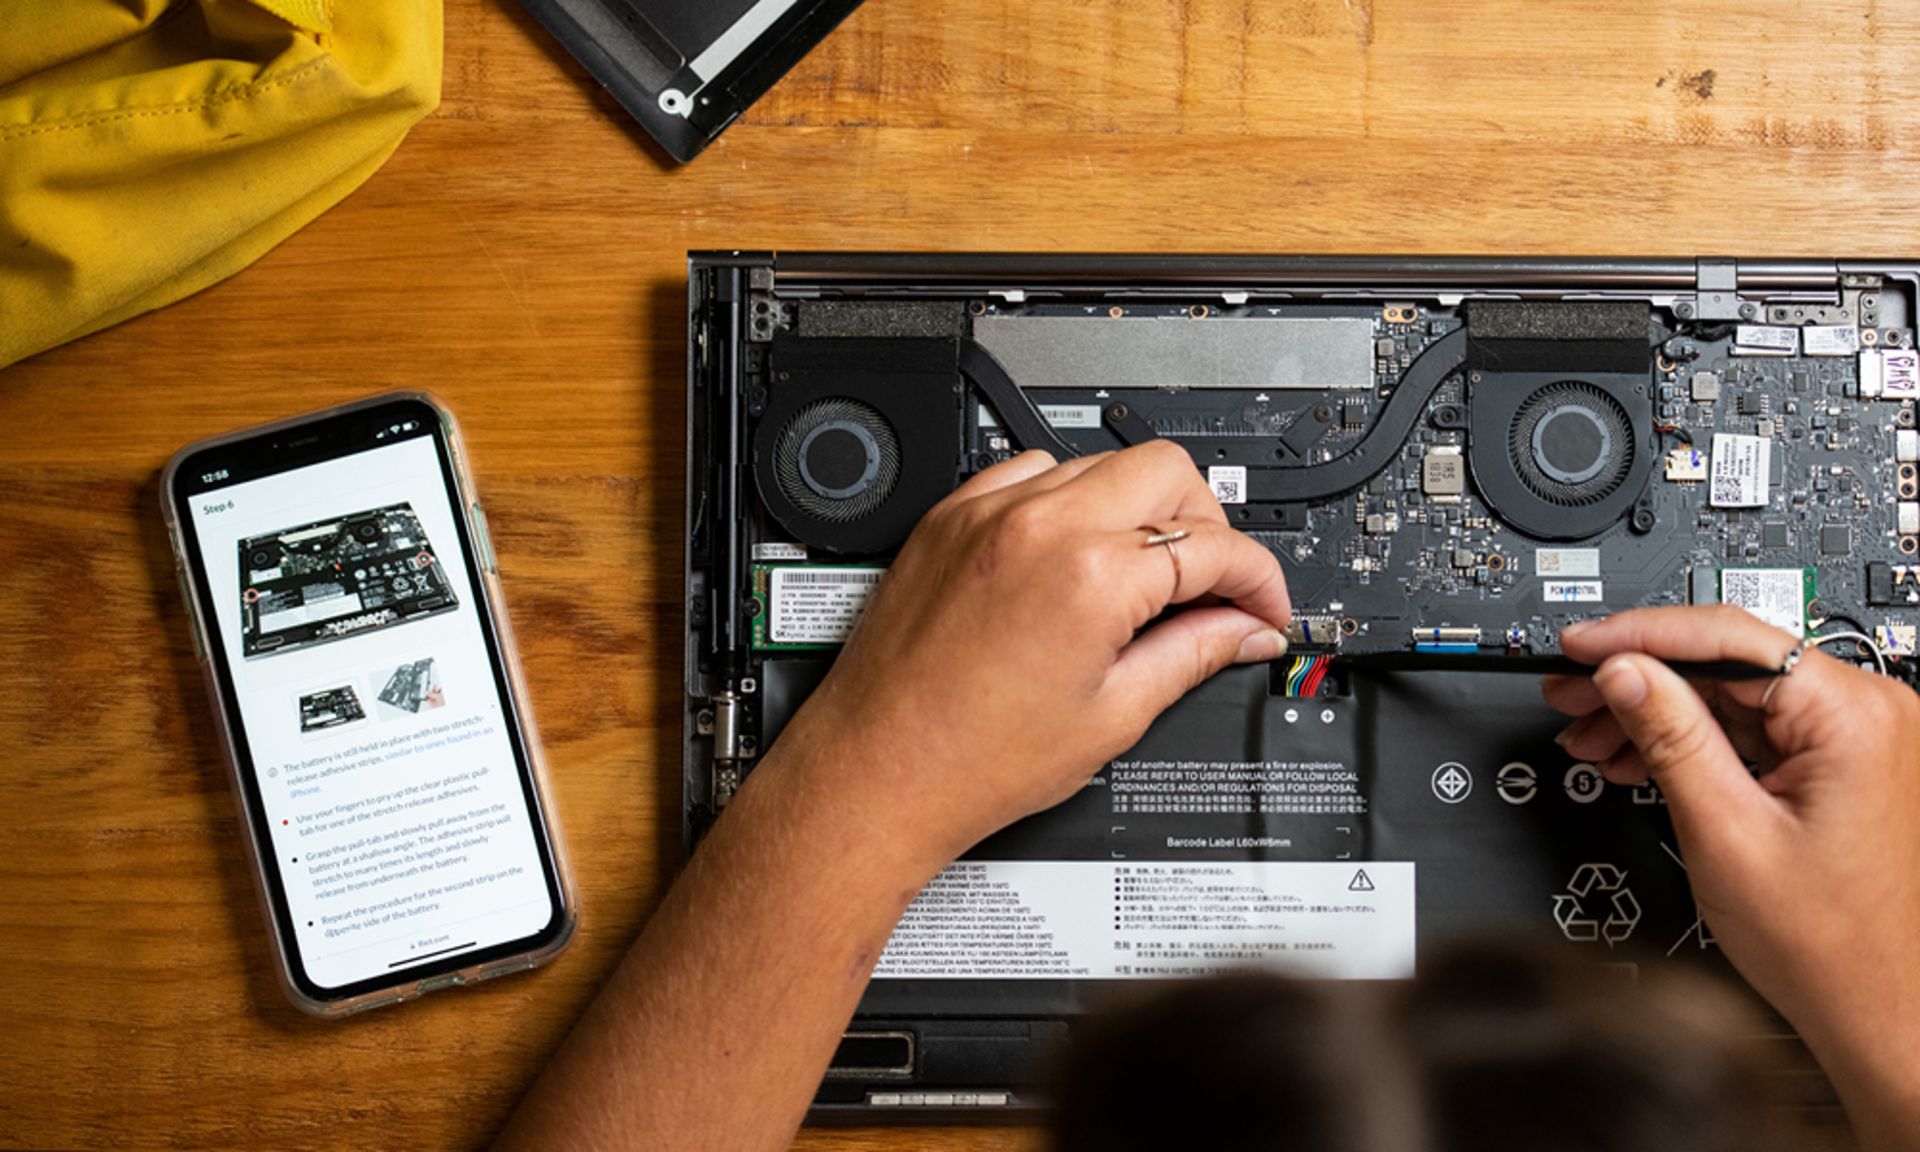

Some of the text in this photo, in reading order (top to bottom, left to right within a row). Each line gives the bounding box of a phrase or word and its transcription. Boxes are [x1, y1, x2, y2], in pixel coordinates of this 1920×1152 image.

[201, 469, 229, 483] 12:58
[203, 500, 234, 515] Step 6
[284, 764, 299, 772] The
[301, 756, 332, 768] battery
[342, 747, 358, 757] still
[359, 742, 378, 752] held
[389, 735, 410, 746] place
[412, 729, 432, 739] with
[432, 725, 449, 734] two
[287, 773, 317, 785] release
[320, 763, 356, 777] adhesive
[446, 731, 471, 743] found
[1111, 762, 1129, 770] Use
[1130, 762, 1140, 770] of
[1142, 762, 1175, 770] another
[1177, 762, 1208, 771] battery
[1210, 763, 1229, 771] may
[1230, 762, 1264, 771] present
[1272, 762, 1287, 770] fire
[1300, 762, 1345, 771] explosion.
[1111, 771, 1359, 782] PLEASE REFER TO USER MANUAL OR FOLLOW LOCAL
[1111, 782, 1358, 794] ORDINANCES AND/OR REGULATIONS FOR DISPOSAL
[295, 814, 312, 823] Use
[315, 808, 332, 819] your
[335, 801, 364, 812] fingers
[376, 794, 390, 803] pry
[393, 790, 403, 798] up
[404, 786, 418, 795] the
[420, 780, 440, 790] clear
[442, 773, 469, 786] plastic
[299, 826, 314, 836] tab
[329, 819, 344, 828] one
[347, 815, 355, 824] of
[357, 812, 370, 821] the
[372, 803, 403, 816] stretch
[404, 796, 434, 808] release
[305, 804, 504, 861] Grasp the pull-tab and slowly pull away from the
[308, 861, 340, 874] battery
[342, 857, 351, 865] at
[358, 848, 391, 860] shallow
[418, 836, 434, 844] The
[437, 826, 473, 840] adhesive
[474, 820, 495, 830] strip
[495, 814, 510, 824] will
[1166, 836, 1207, 848] Barcode
[1208, 837, 1236, 848] Label
[312, 872, 342, 886] stretch
[343, 871, 353, 879] to
[354, 865, 377, 875] many
[445, 841, 461, 852] and
[461, 835, 488, 847] slowly
[315, 886, 345, 899] release
[347, 881, 368, 890] from
[419, 863, 433, 872] the
[321, 911, 351, 924] Repeat
[353, 908, 366, 916] the
[368, 896, 412, 913] procedure
[427, 888, 442, 896] the
[443, 878, 474, 892] second
[475, 874, 495, 884] strip
[496, 870, 508, 878] on
[508, 867, 522, 875] the
[363, 918, 379, 927] side
[382, 913, 390, 922] of
[391, 911, 405, 920] the
